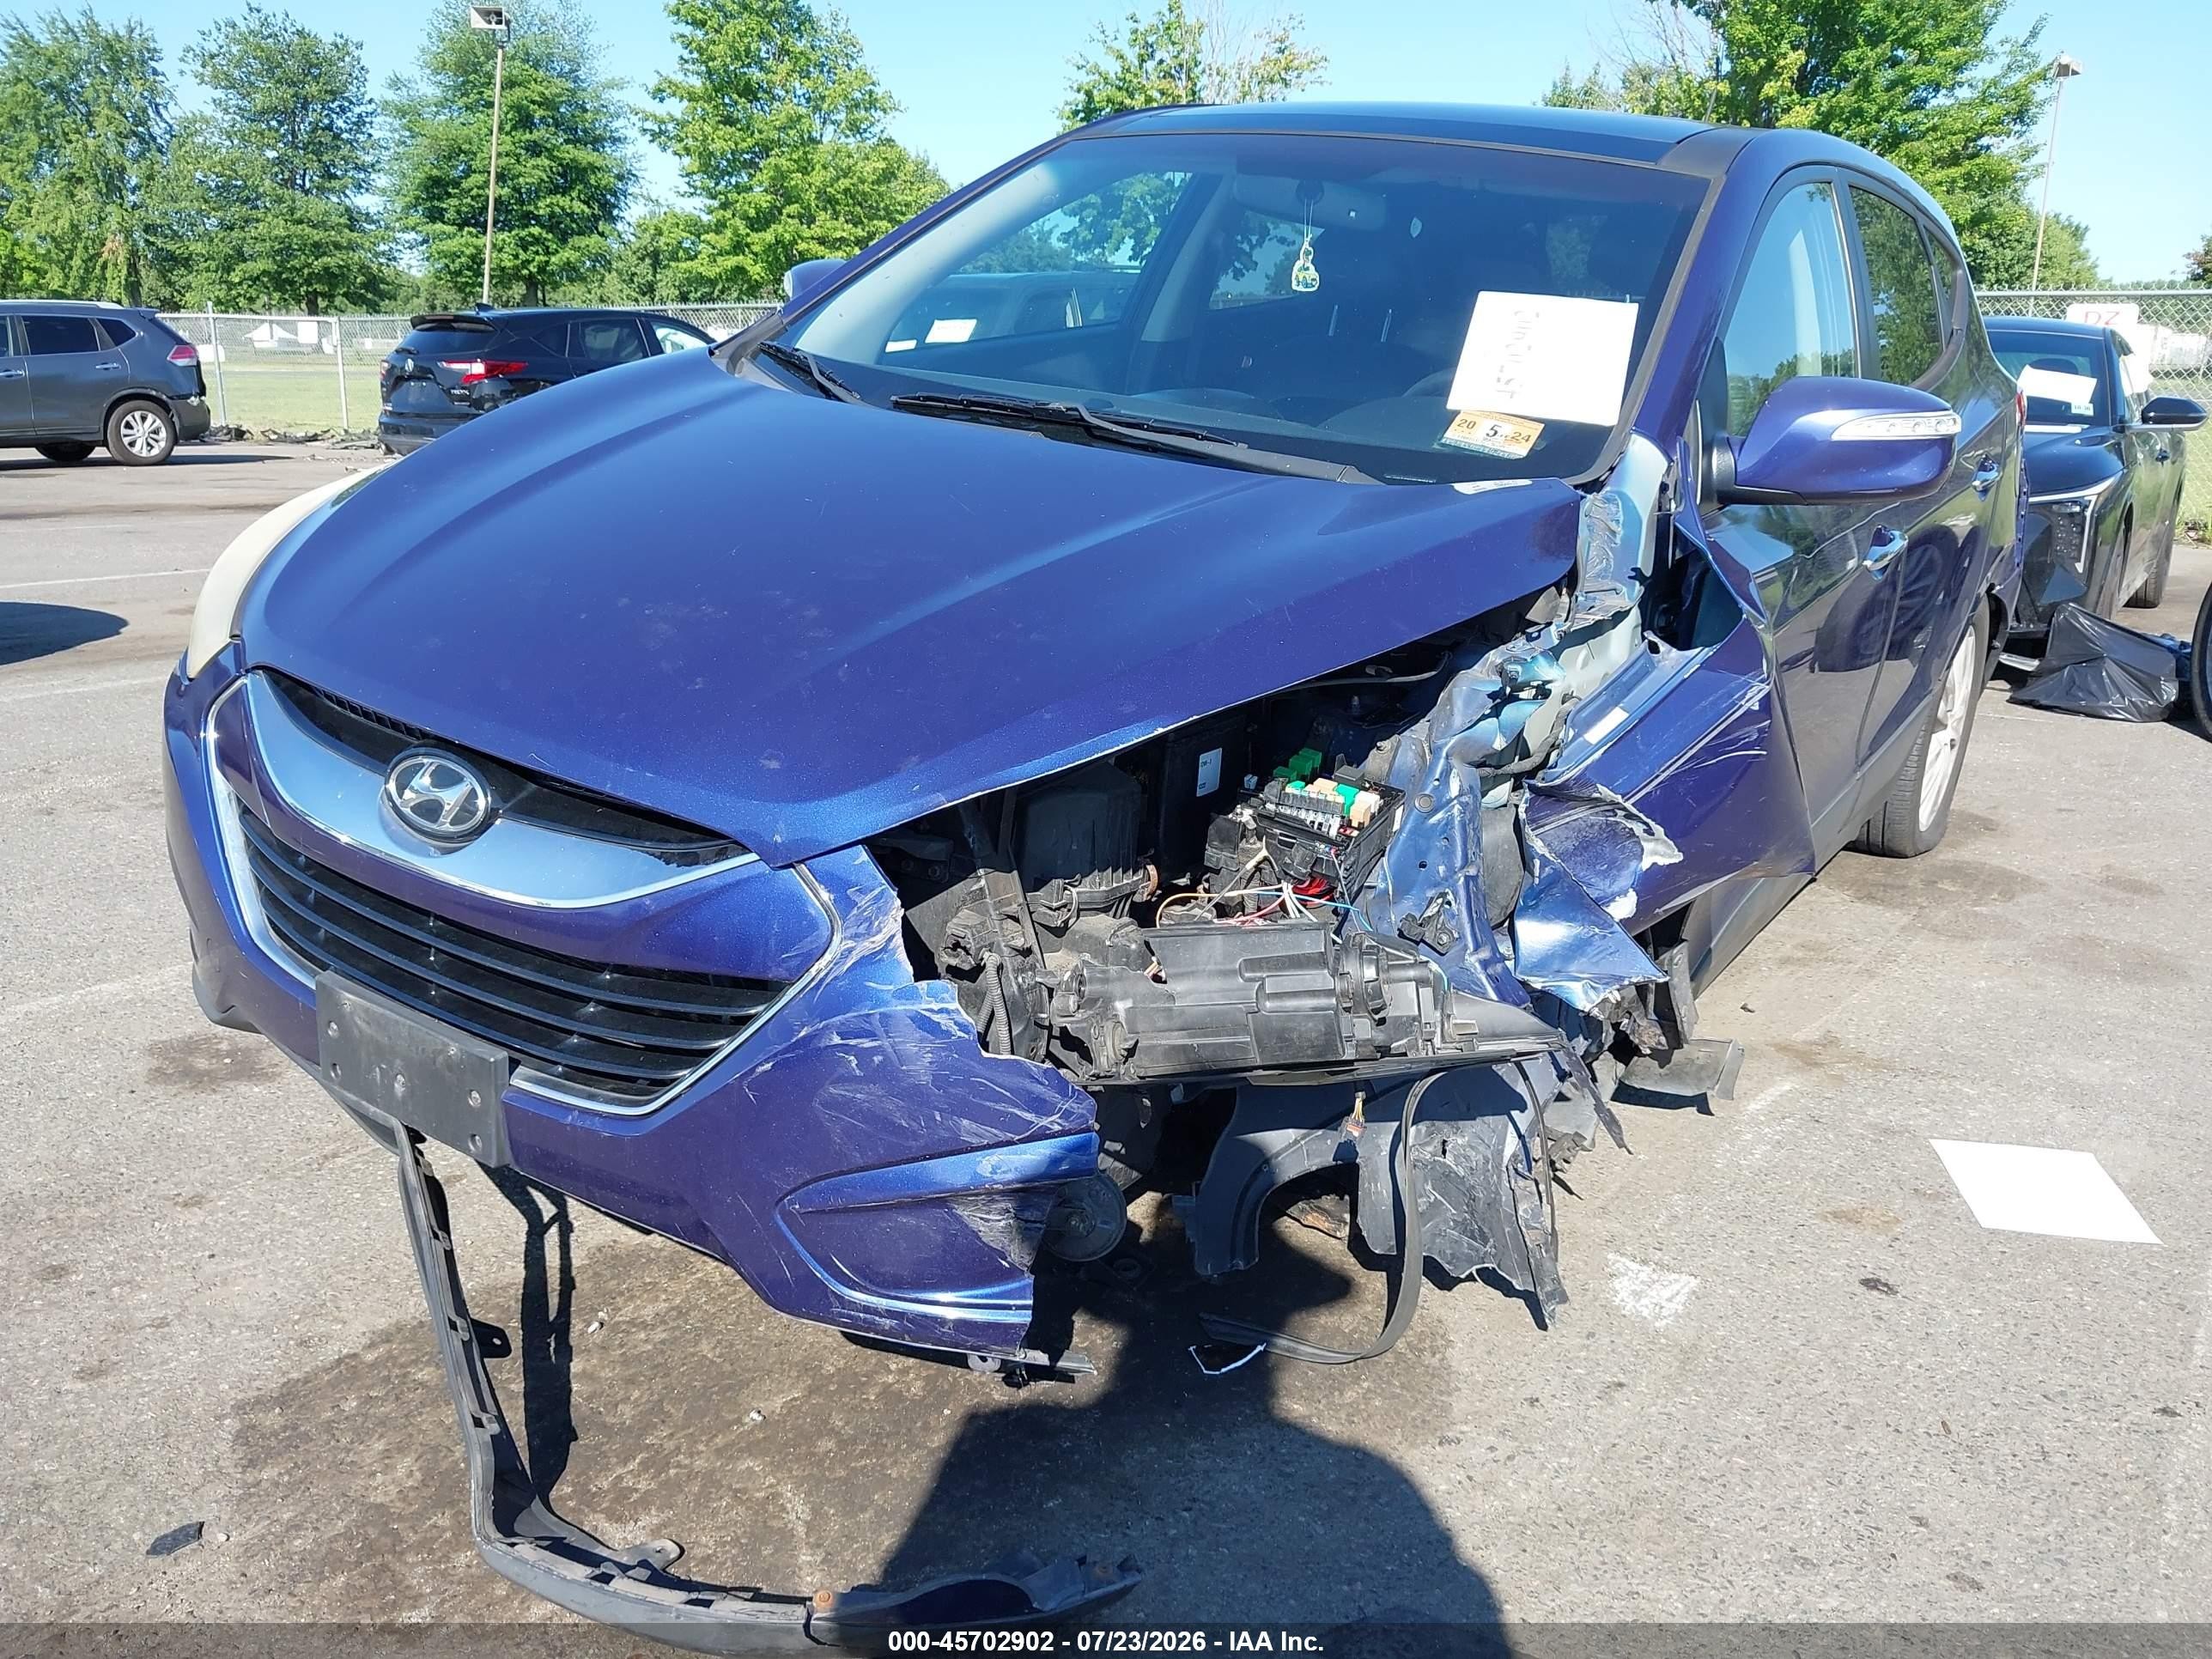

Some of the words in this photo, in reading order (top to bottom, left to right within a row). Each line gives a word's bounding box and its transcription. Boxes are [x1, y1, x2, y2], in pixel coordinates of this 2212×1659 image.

[1456, 418, 1477, 430] 20
[1486, 424, 1503, 438] 5
[1510, 431, 1532, 444] 24
